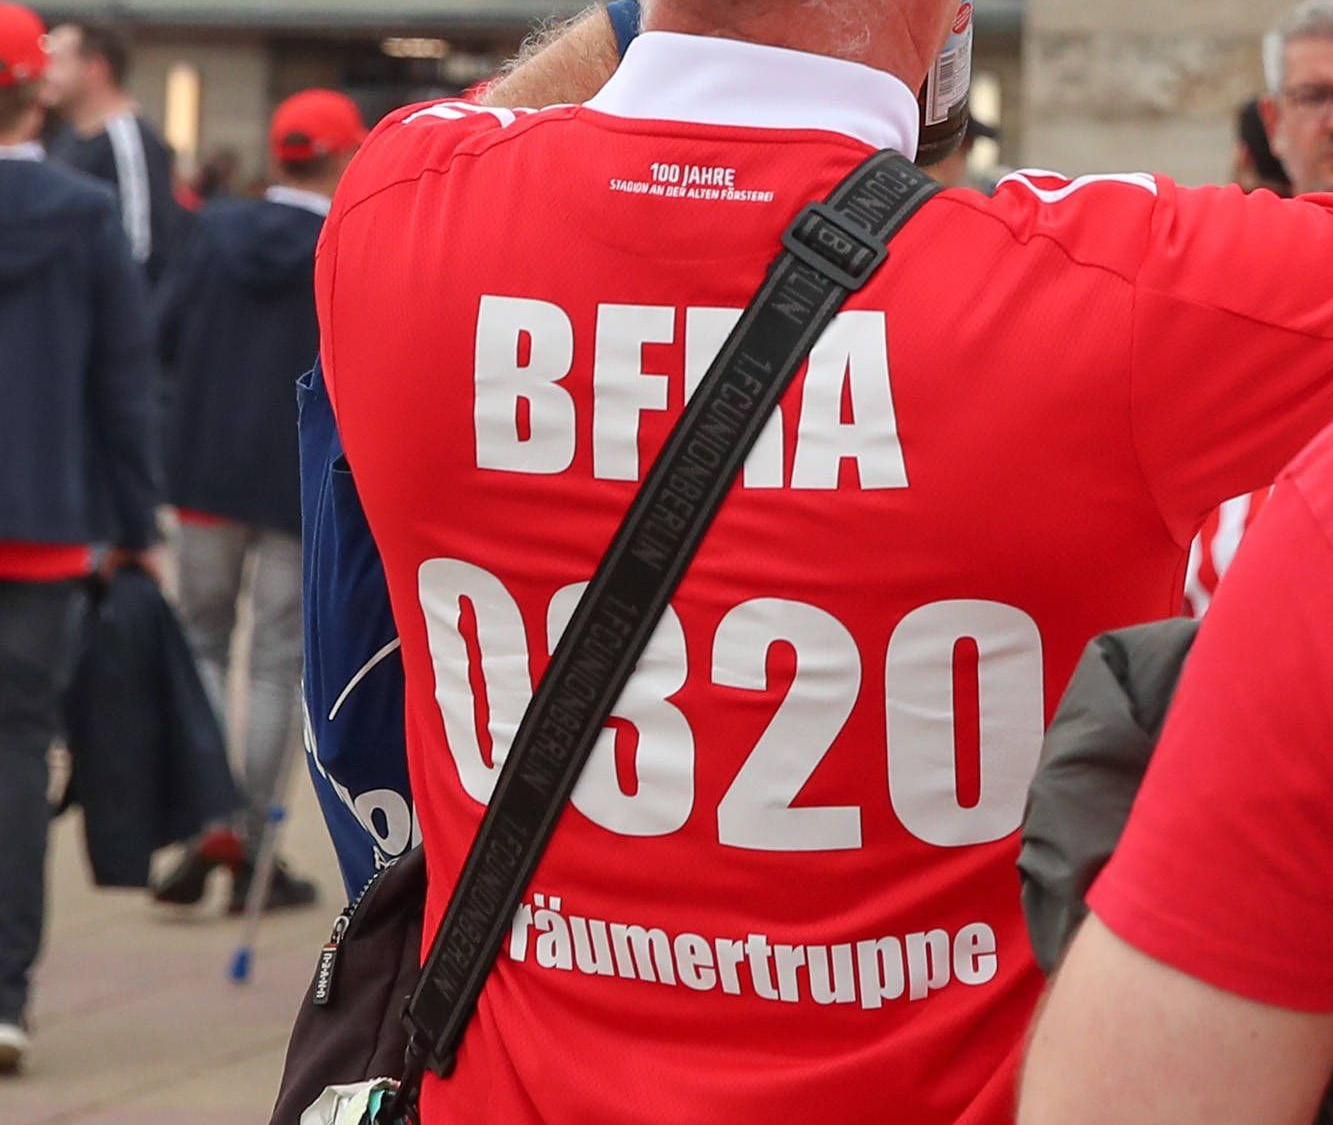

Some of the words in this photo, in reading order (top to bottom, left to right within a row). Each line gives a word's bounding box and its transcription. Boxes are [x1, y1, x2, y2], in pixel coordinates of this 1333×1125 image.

[609, 178, 649, 195] STADION
[649, 184, 664, 196] AN
[687, 188, 719, 200] ALTEN
[721, 186, 774, 203] FÖRSTEREI
[650, 162, 680, 183] 100
[682, 165, 736, 187] JAHRE
[417, 557, 1045, 852] 0320
[509, 893, 998, 1010] räumertruppe
